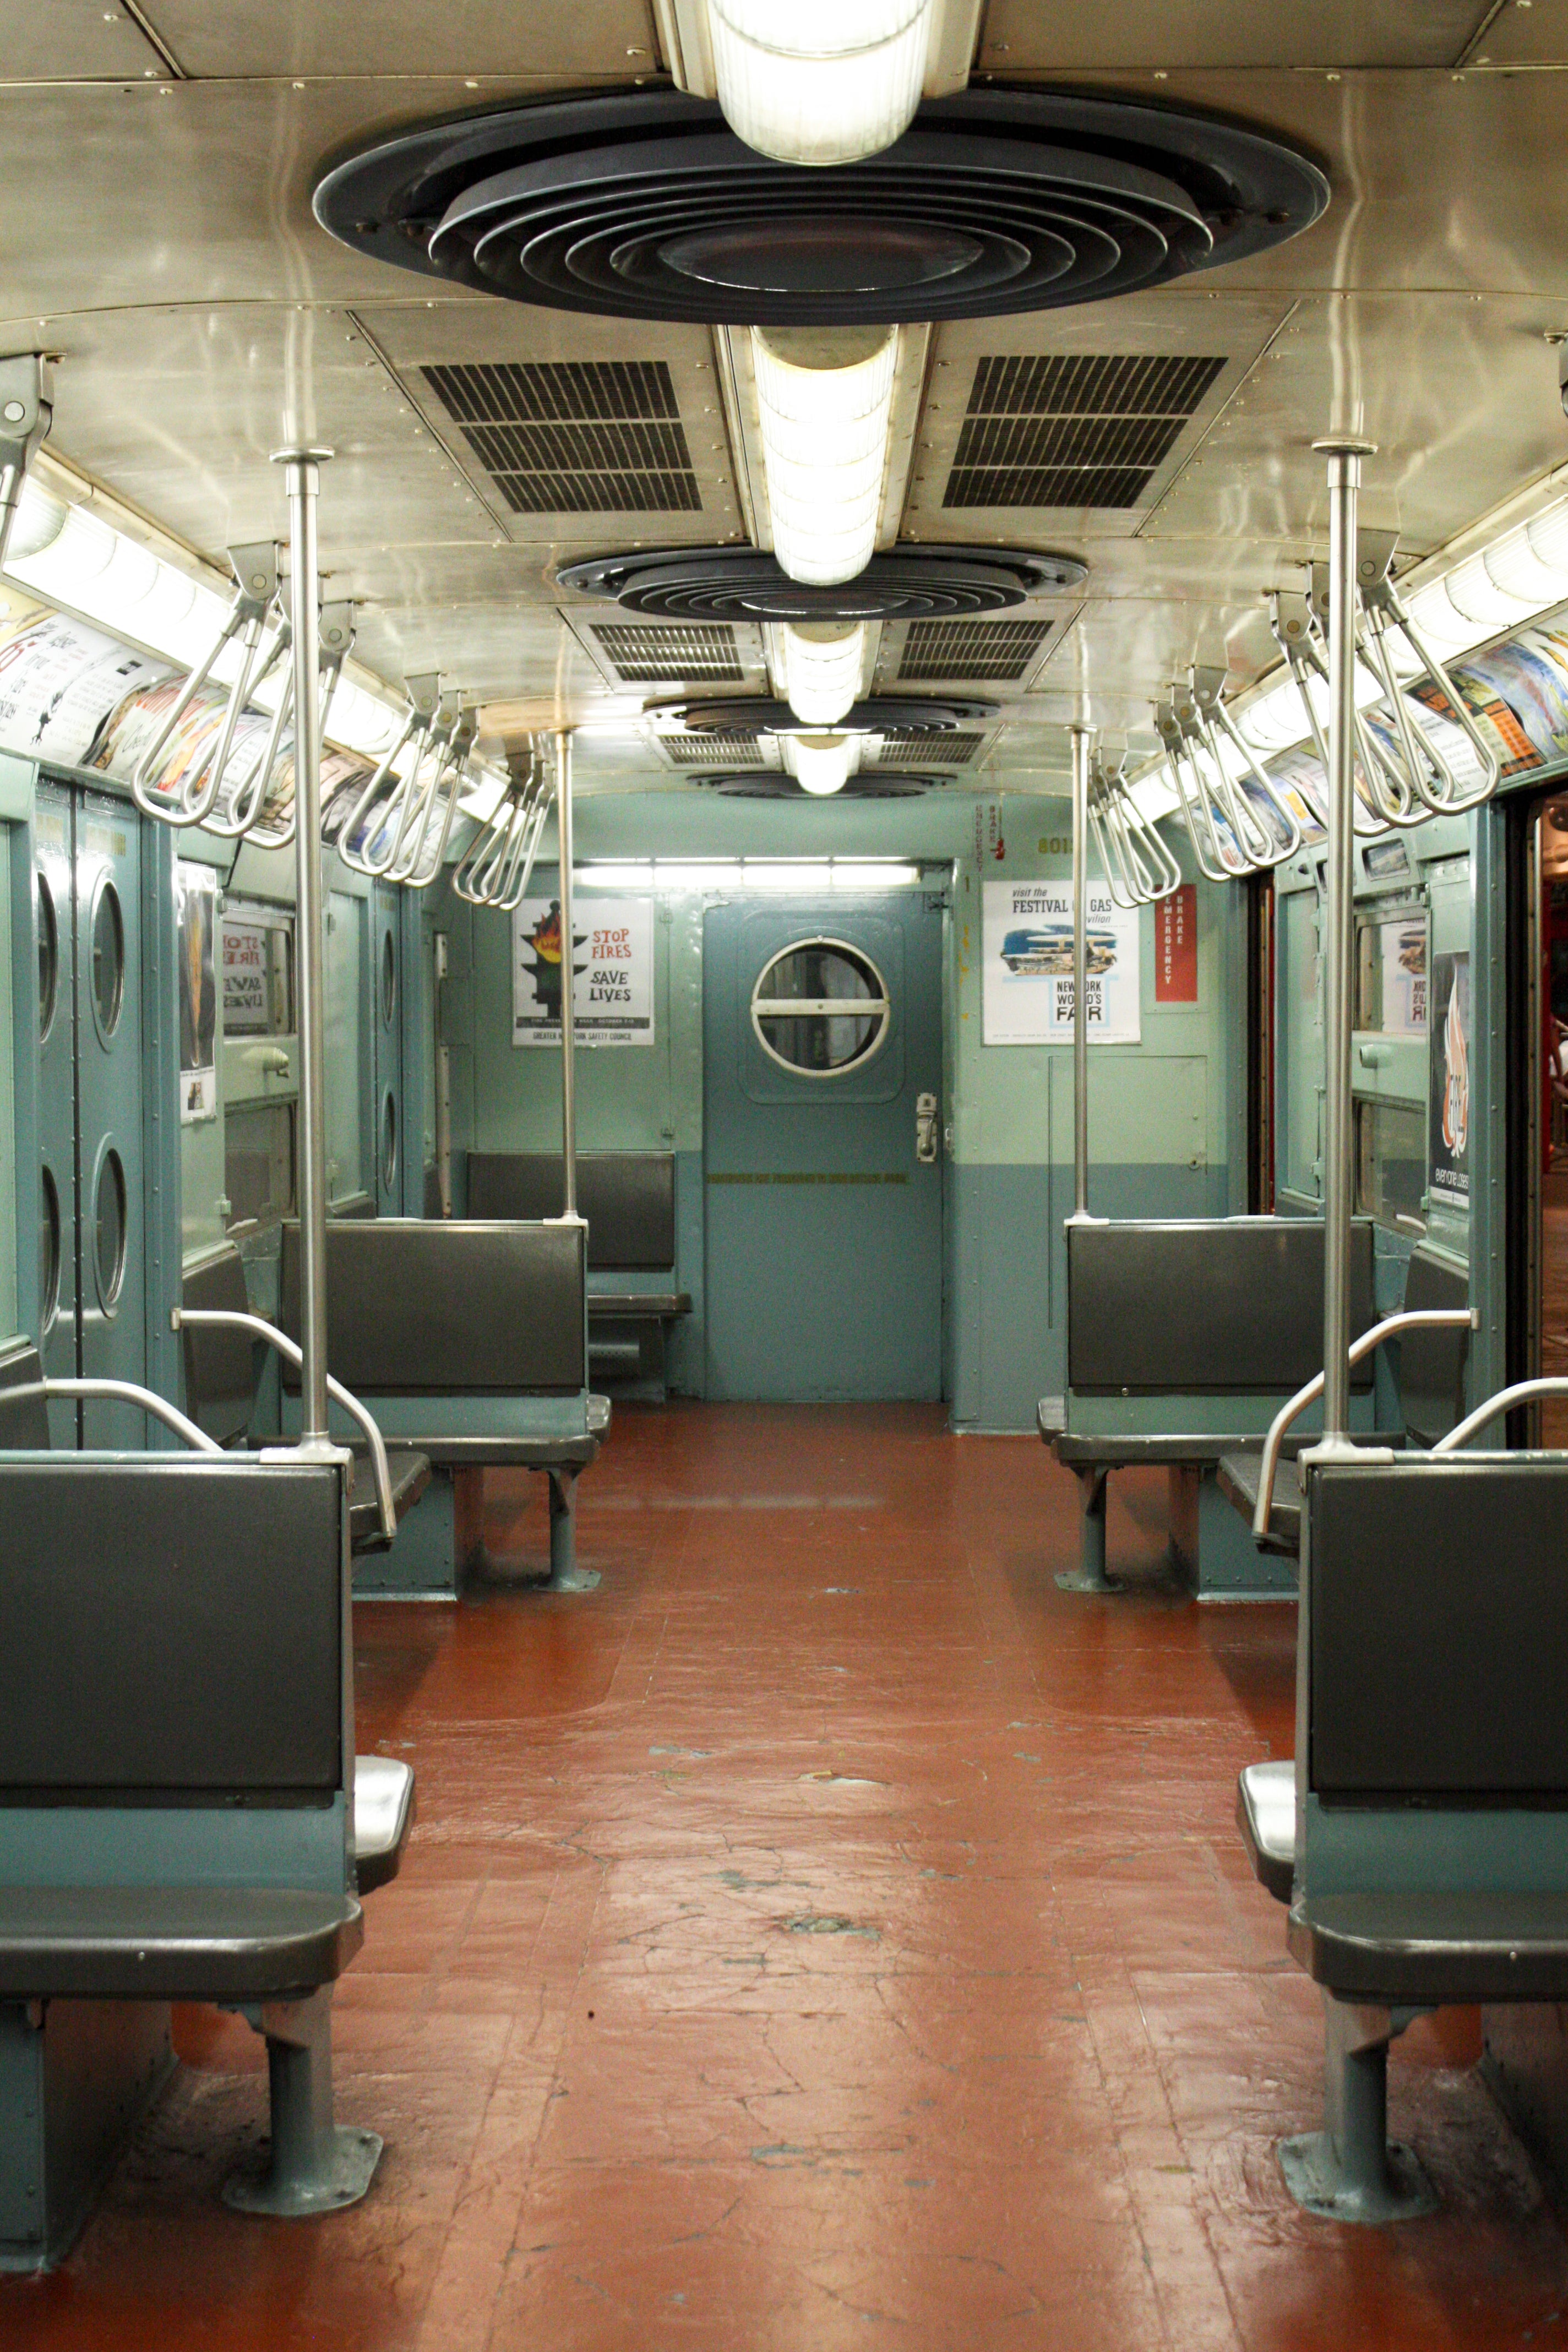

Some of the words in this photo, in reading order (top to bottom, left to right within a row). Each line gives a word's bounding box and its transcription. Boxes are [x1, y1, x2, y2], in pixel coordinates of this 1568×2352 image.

[1012, 888, 1031, 897] visit
[1033, 887, 1047, 897] the
[1012, 899, 1068, 913] FESTIVAL
[1090, 899, 1112, 912] GAS
[592, 928, 629, 943] STOP
[1164, 895, 1172, 984] EMERGENCY
[591, 944, 631, 959] FIRES
[590, 971, 629, 985] SAVE
[1086, 981, 1101, 992] ORK
[589, 988, 631, 1003] LIVES
[1057, 993, 1102, 1005] WOD'S
[1057, 1006, 1102, 1021] FAR
[589, 1032, 607, 1041] SAFETY
